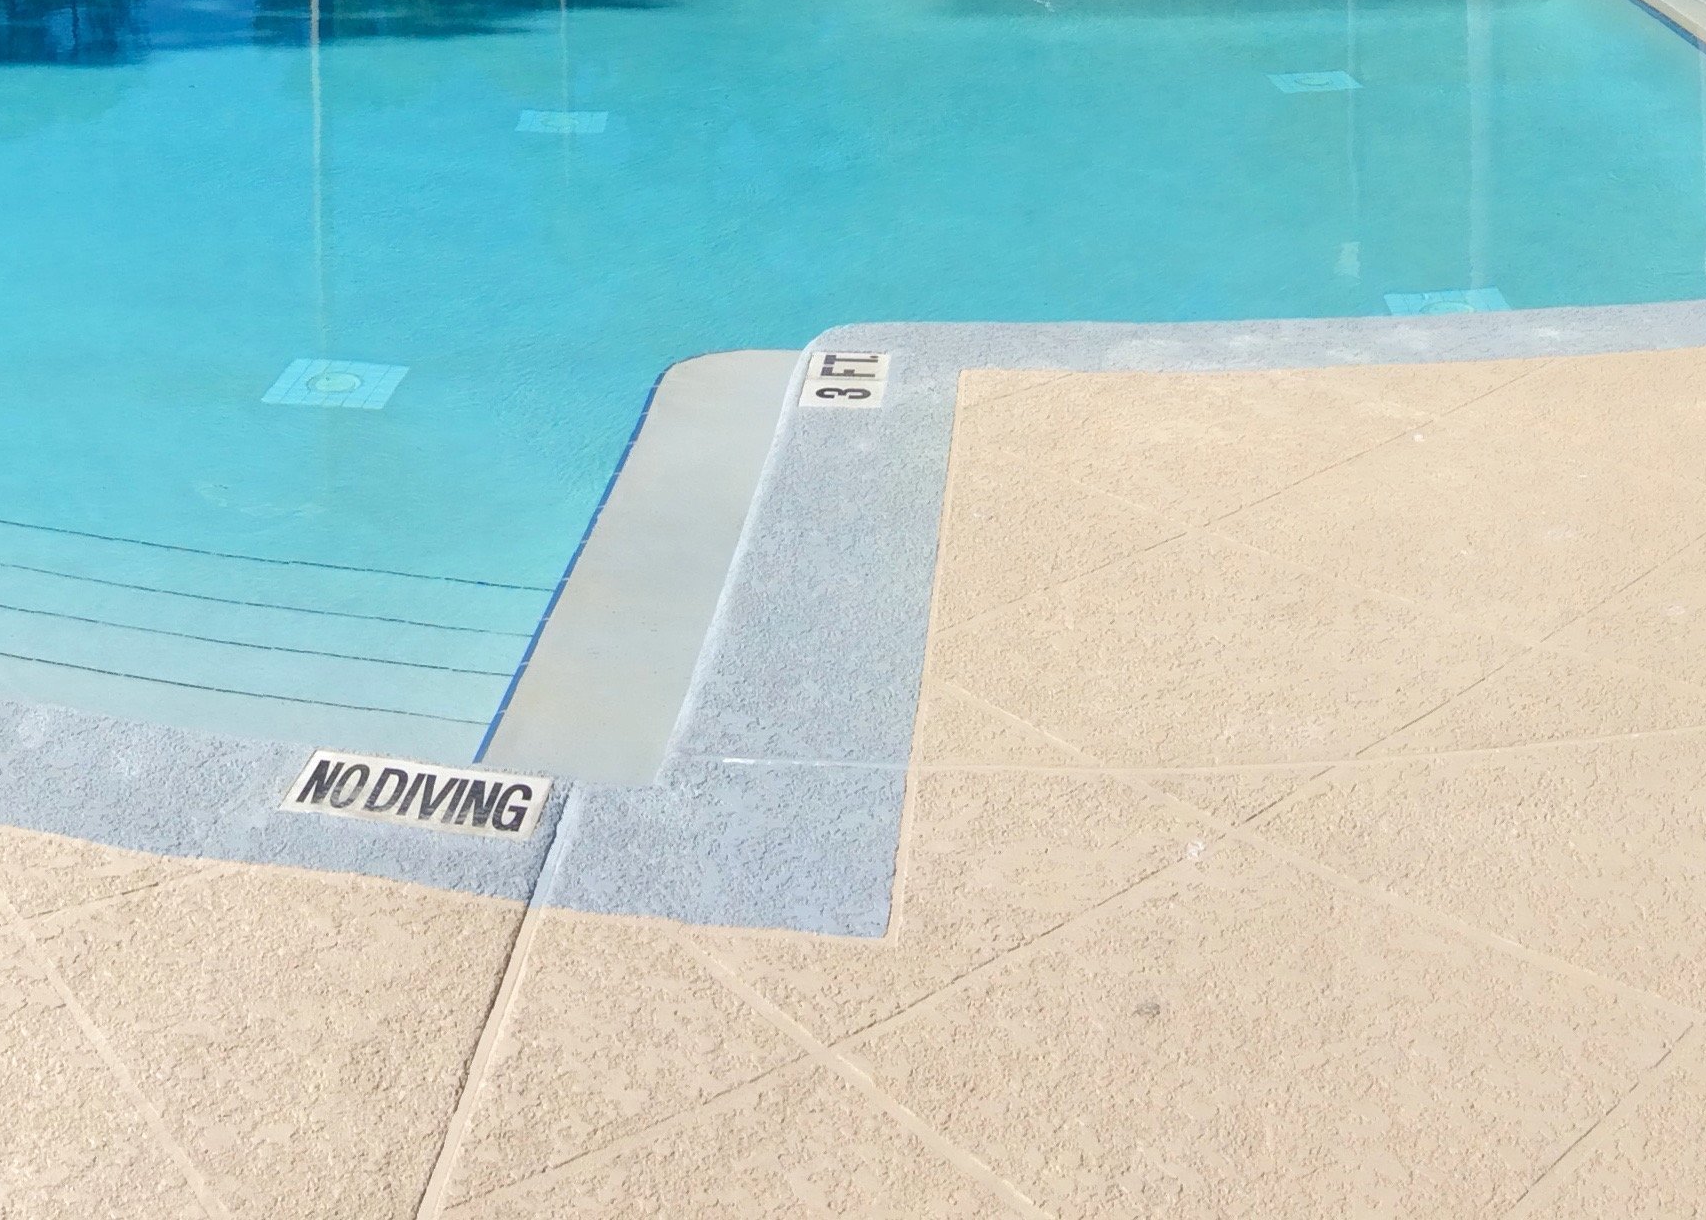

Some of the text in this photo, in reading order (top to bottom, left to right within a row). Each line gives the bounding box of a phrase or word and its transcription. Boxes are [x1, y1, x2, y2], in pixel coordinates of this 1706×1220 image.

[815, 387, 871, 399] 3
[295, 759, 533, 832] NO DIVING
